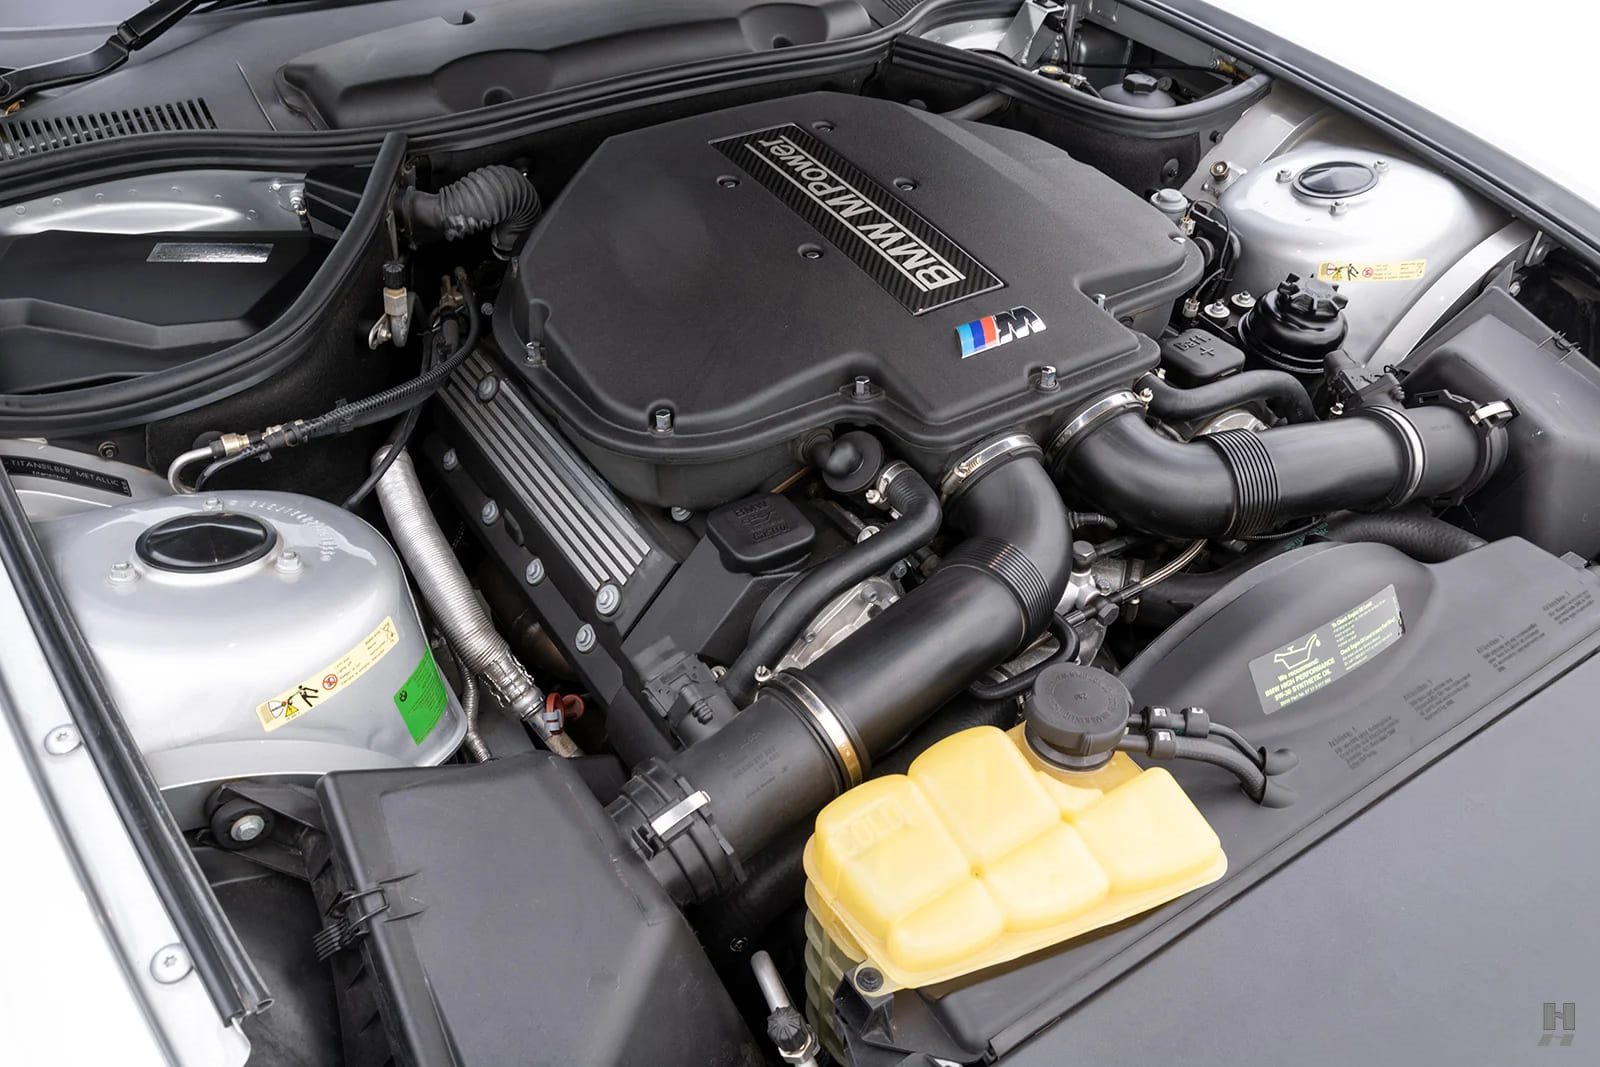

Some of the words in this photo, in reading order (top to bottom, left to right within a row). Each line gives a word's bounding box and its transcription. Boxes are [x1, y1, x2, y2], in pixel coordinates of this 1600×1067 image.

[857, 222, 961, 291] BMW
[11, 459, 71, 475] TITANSILBER
[75, 470, 119, 487] METALLIC
[1280, 676, 1296, 690] HIGH
[1294, 656, 1335, 683] PERFORMANCE
